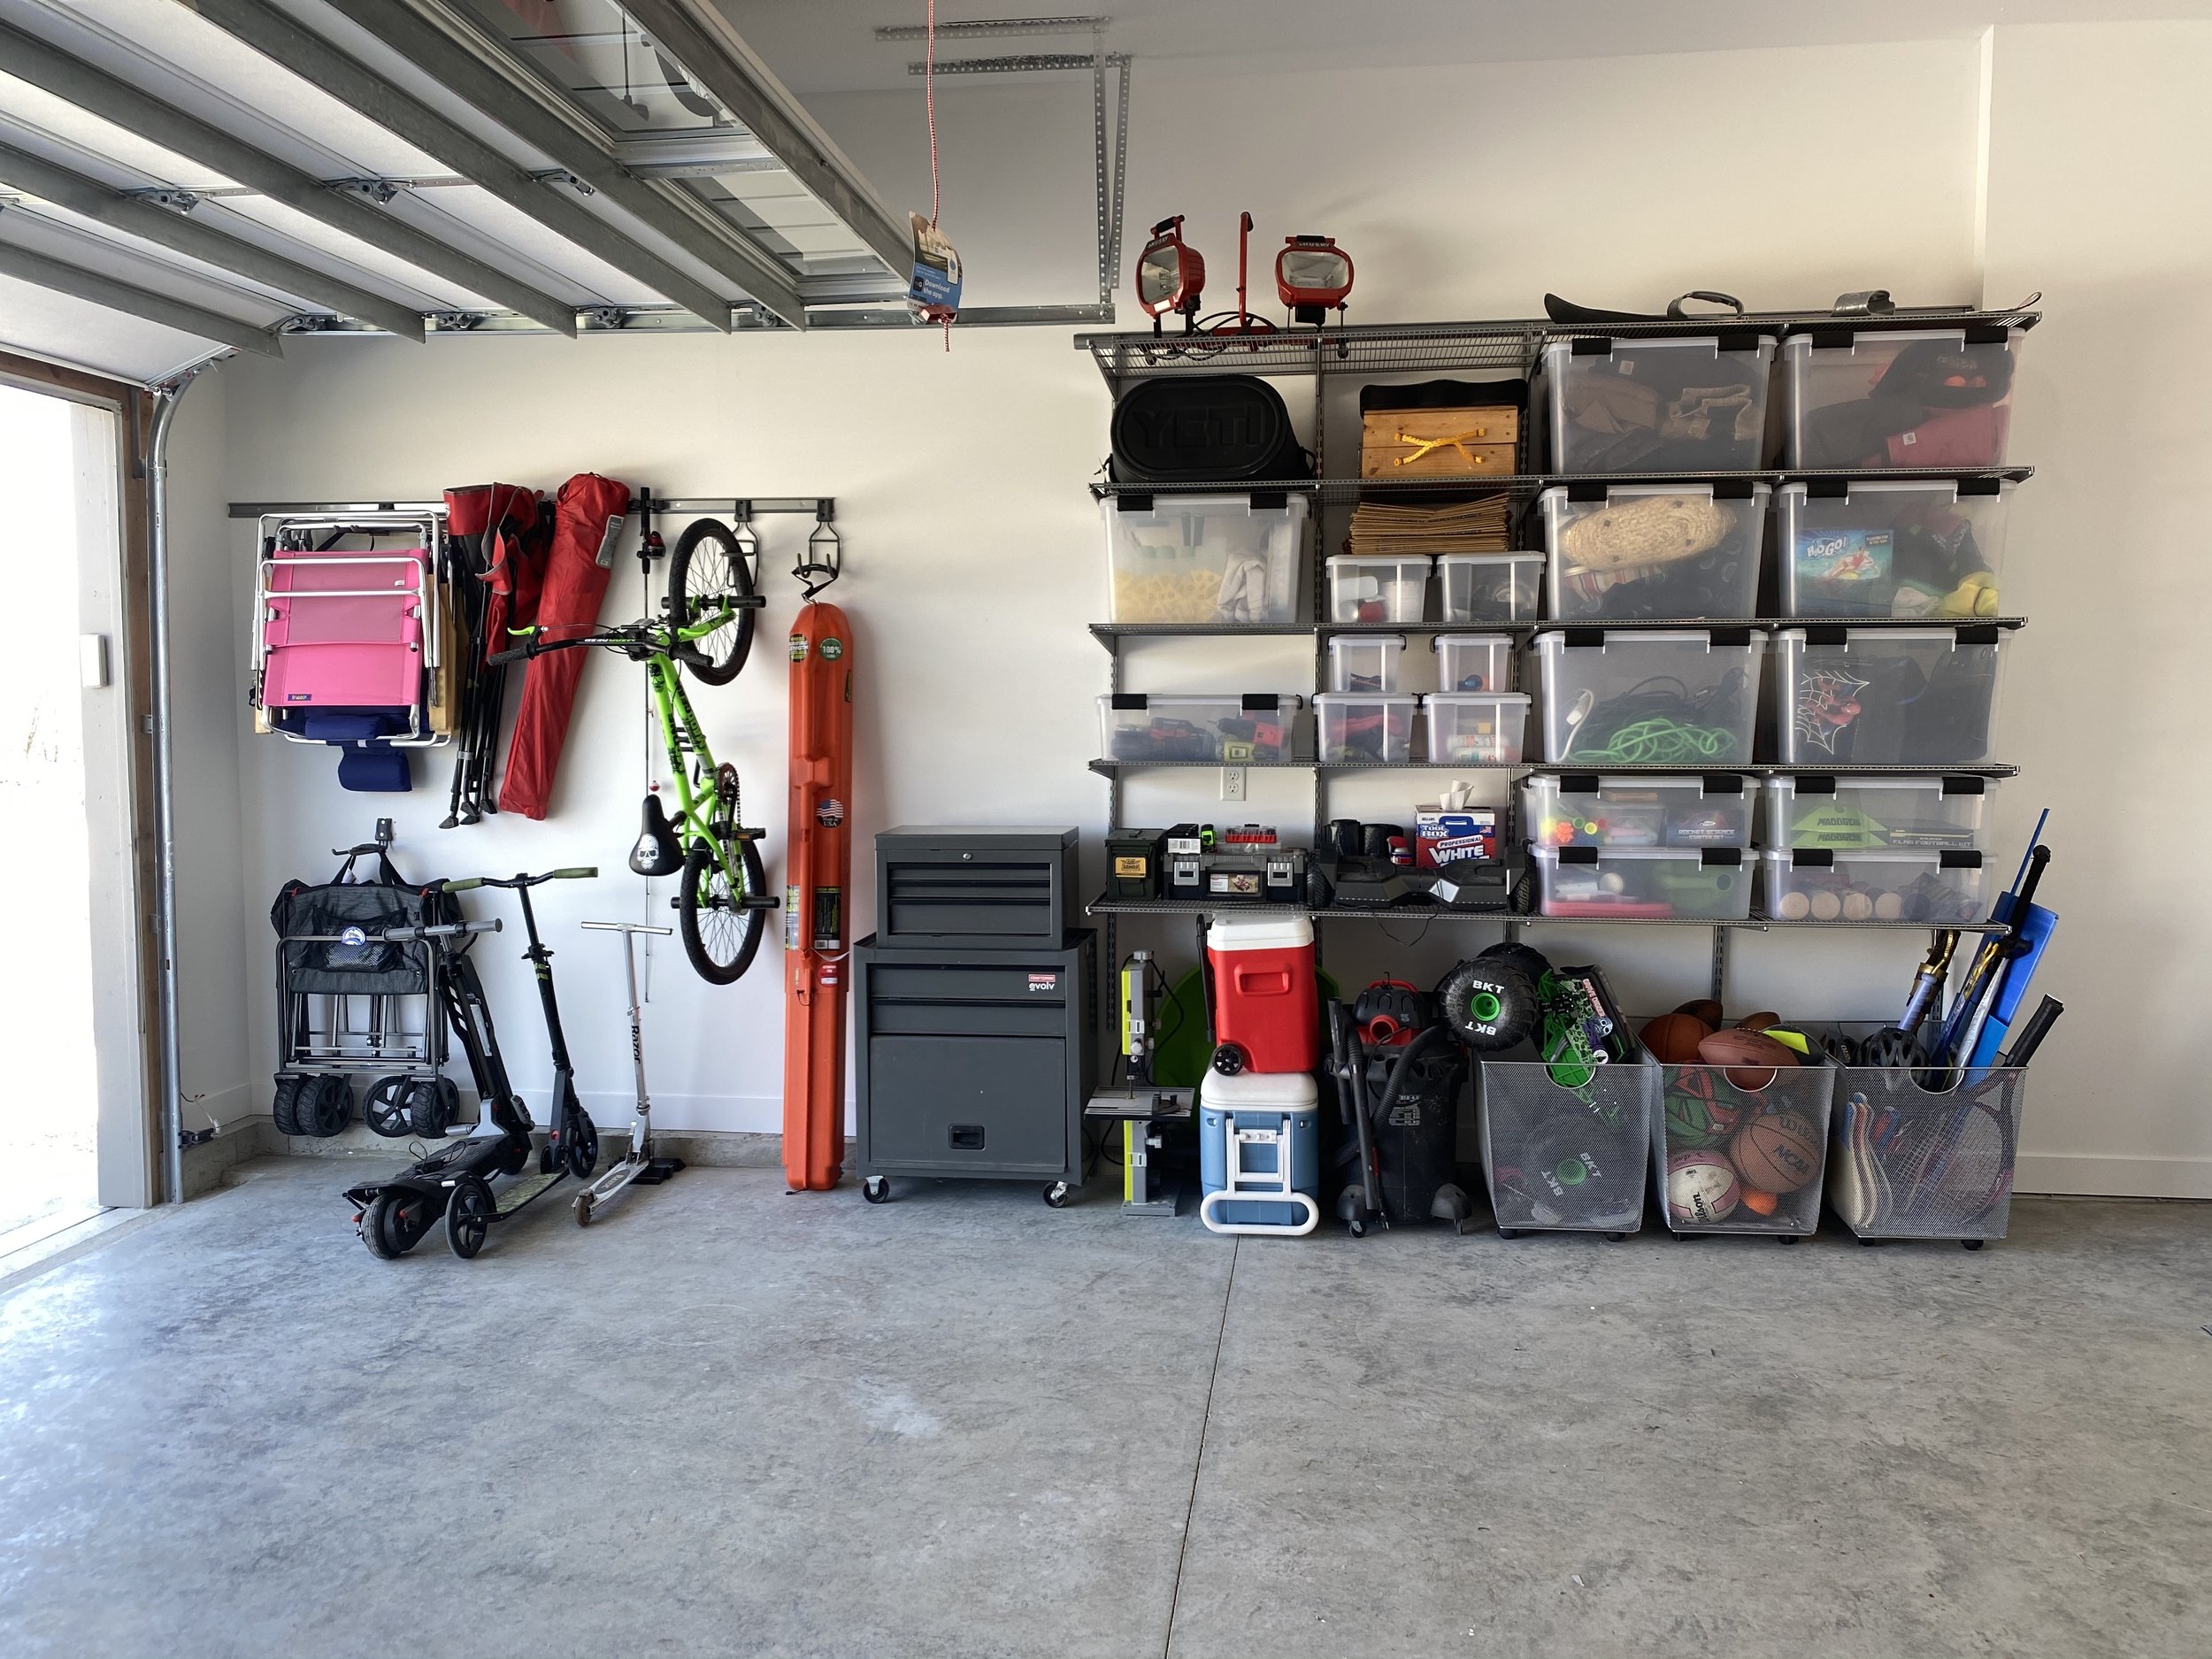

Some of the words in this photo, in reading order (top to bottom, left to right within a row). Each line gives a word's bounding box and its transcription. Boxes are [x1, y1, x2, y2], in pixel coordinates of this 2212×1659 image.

[1152, 236, 1169, 246] HUSKY
[925, 279, 950, 293] Download
[1133, 403, 1264, 448] YETI
[822, 645, 841, 654] 100%
[1440, 835, 1482, 849] PROFESSIONAL
[1428, 844, 1485, 864] WHITE
[1028, 982, 1055, 991] evolv
[1472, 979, 1505, 994] BKT
[1582, 978, 1597, 998] GRAVE
[1591, 996, 1606, 1018] DIGGER
[1464, 1021, 1497, 1036] BKT
[631, 1025, 641, 1064] Razor
[1579, 1152, 1602, 1179] BKT
[1540, 1171, 1564, 1196] BKT
